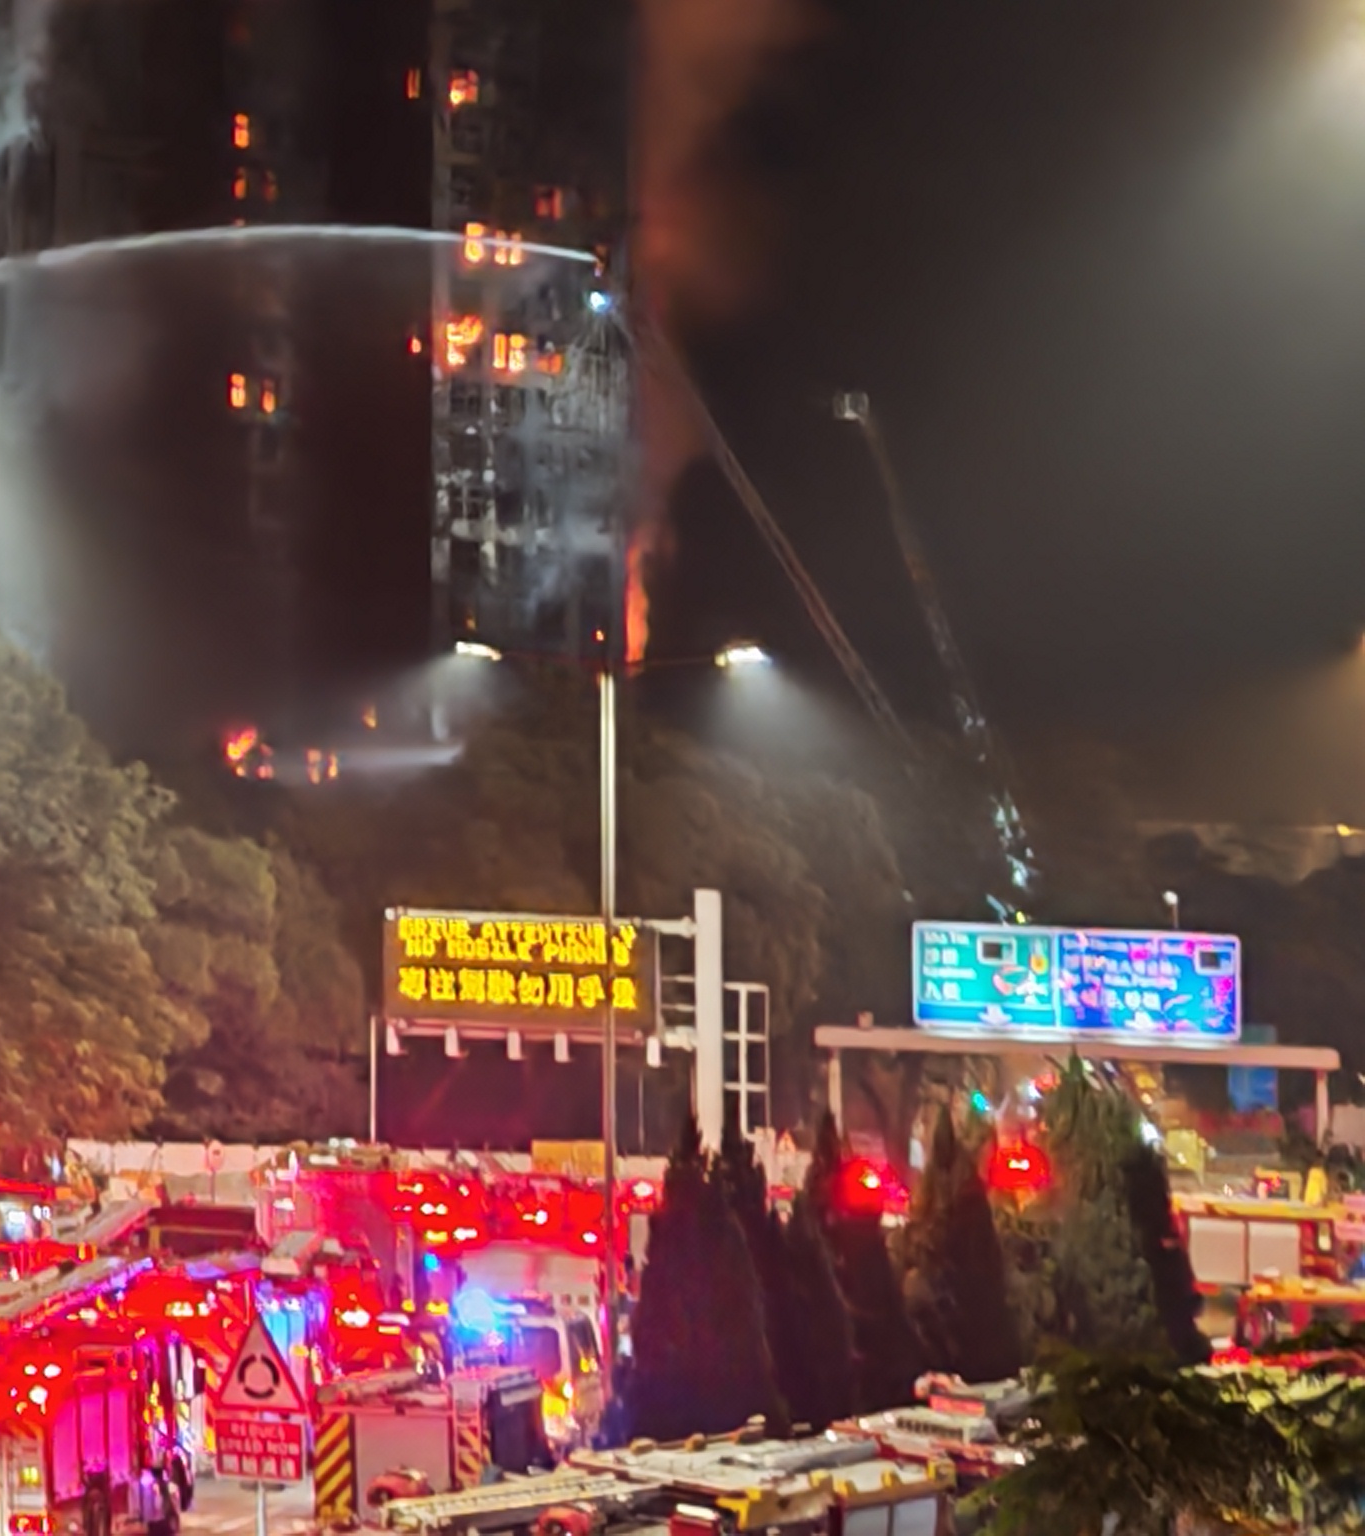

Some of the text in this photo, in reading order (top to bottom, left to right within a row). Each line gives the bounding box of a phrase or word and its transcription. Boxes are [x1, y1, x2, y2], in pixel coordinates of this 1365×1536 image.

[399, 917, 470, 942] DRIVE
[406, 938, 435, 957] NO
[447, 939, 532, 962] MOBILE
